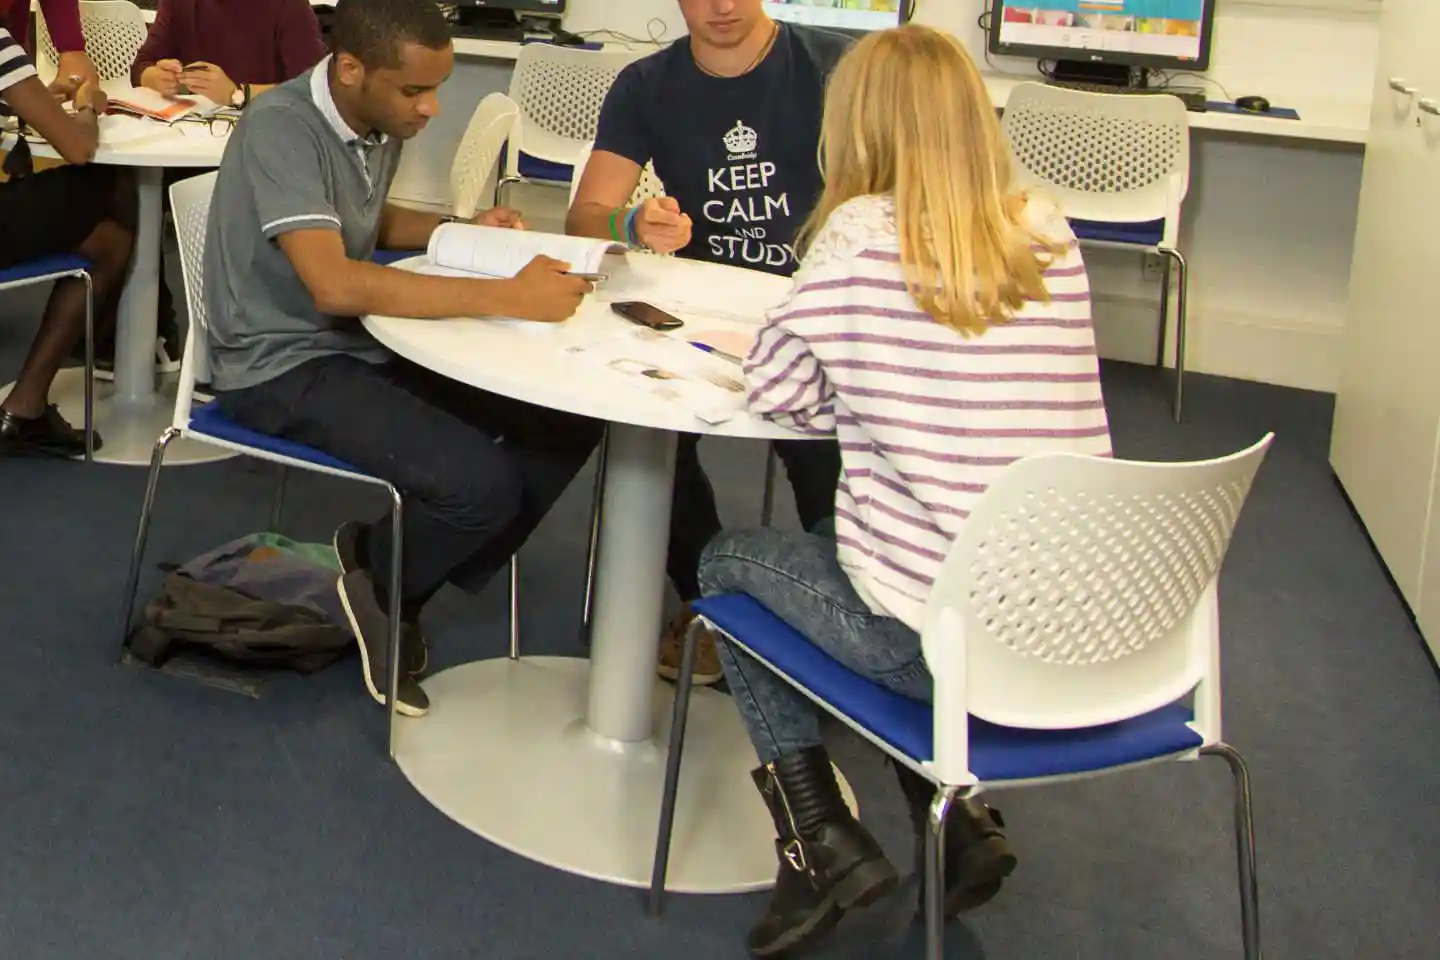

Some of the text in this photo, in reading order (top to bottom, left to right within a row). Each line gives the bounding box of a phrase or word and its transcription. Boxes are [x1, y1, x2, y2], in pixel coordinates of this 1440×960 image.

[708, 161, 776, 192] KEEP
[703, 192, 791, 223] CALM
[735, 227, 767, 240] AND
